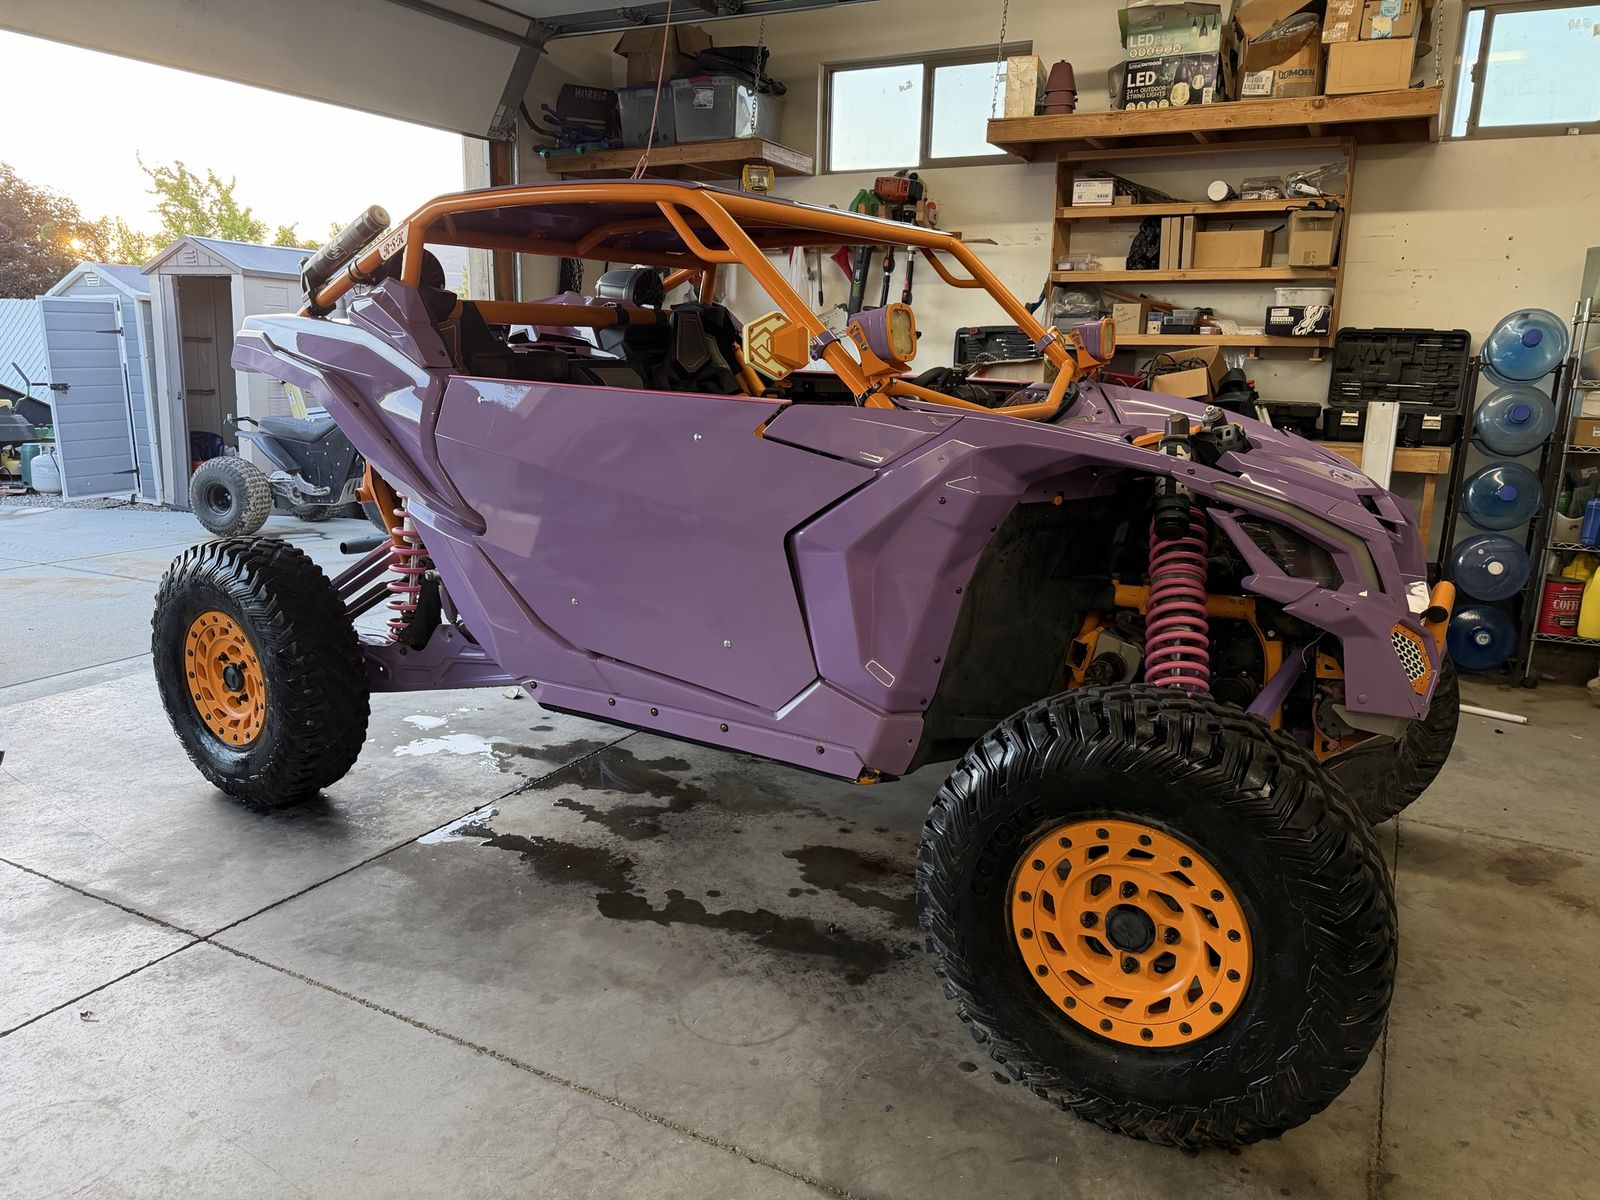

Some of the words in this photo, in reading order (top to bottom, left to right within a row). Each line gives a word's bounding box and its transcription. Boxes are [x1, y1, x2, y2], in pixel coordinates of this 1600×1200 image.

[1129, 33, 1155, 48] LED
[1127, 71, 1156, 88] LED
[1126, 92, 1146, 100] STRING
[1146, 91, 1166, 99] LIGHTS
[1140, 86, 1167, 94] OUTDOOR
